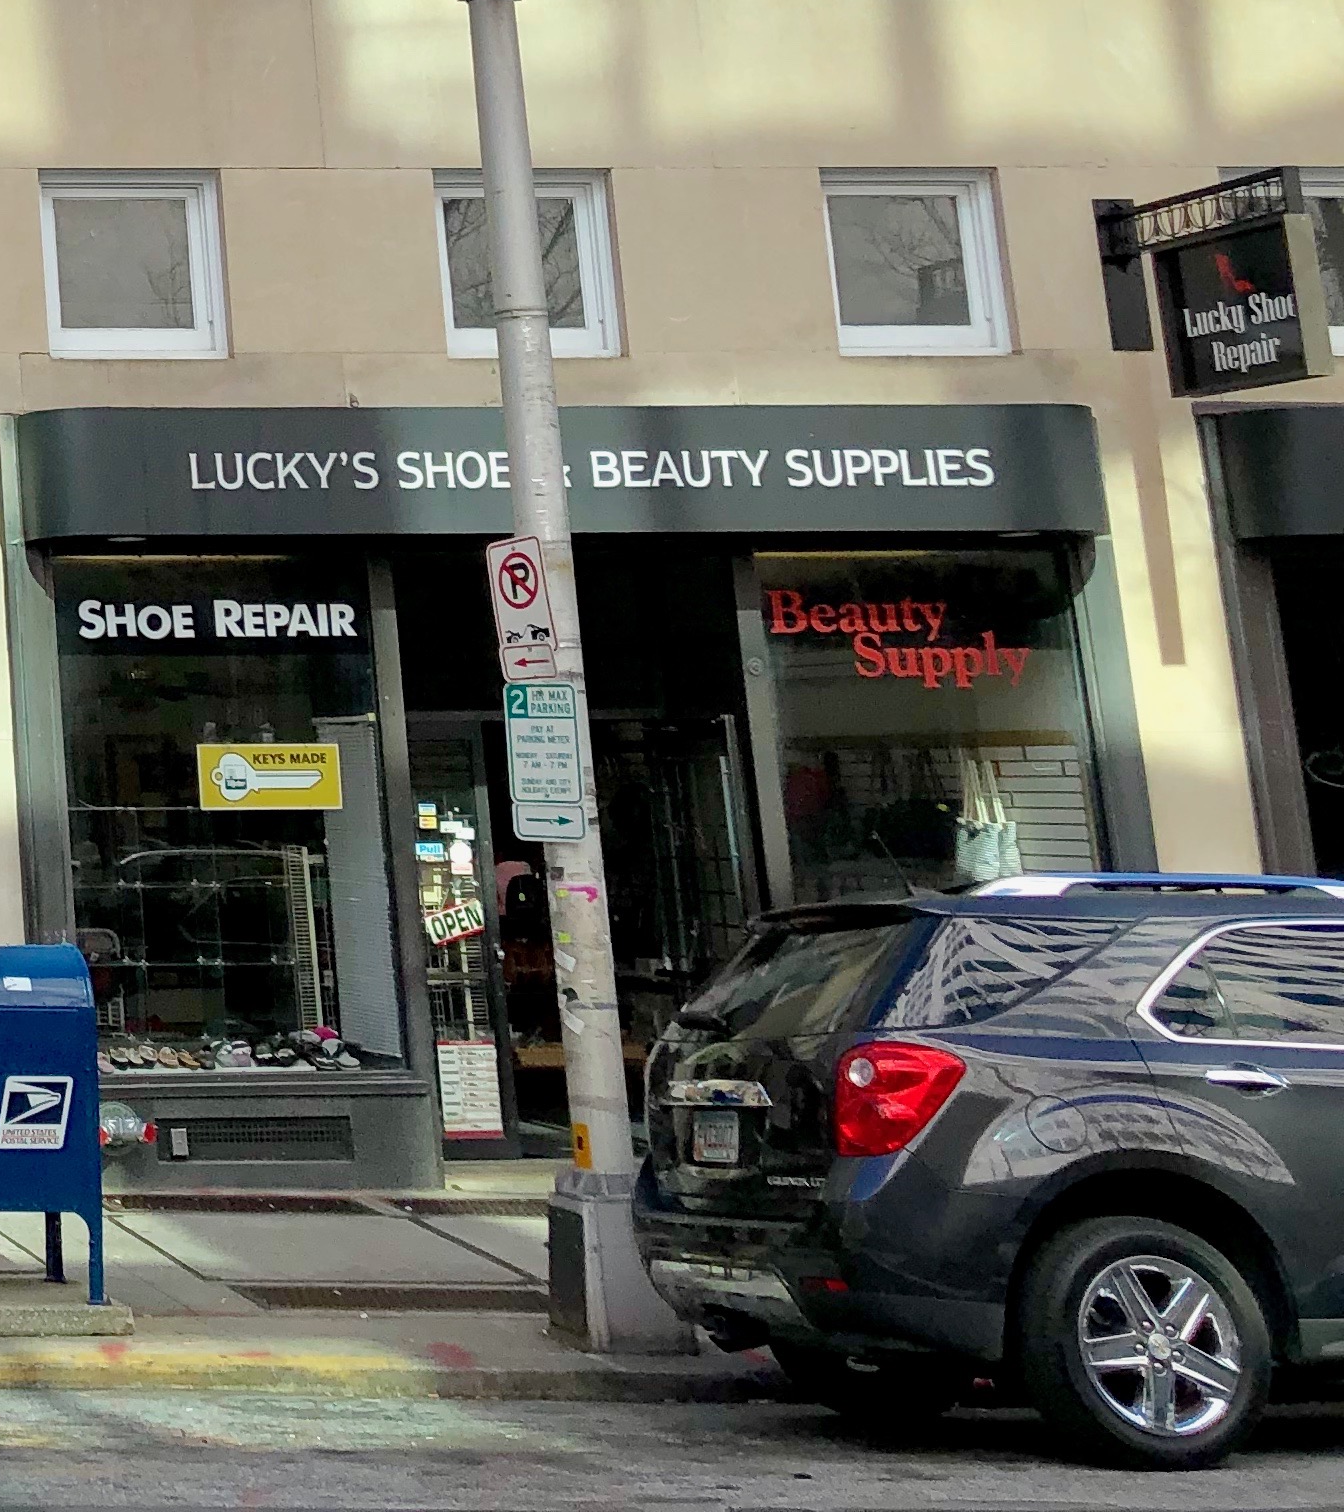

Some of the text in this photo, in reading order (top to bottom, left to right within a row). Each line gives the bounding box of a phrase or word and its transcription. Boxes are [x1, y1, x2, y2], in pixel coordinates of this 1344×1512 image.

[1182, 300, 1245, 338] Lucky
[1211, 332, 1281, 374] Repair
[188, 451, 380, 491] LUCKY'S
[396, 450, 511, 491] SHOE
[592, 449, 768, 489] BEAUTY
[785, 448, 997, 488] SUPPLIES
[78, 598, 358, 640] SHOE REPAIR
[766, 589, 1033, 689] Beauty Supply
[509, 689, 525, 715] 2
[531, 690, 568, 702] HR MAX
[530, 702, 572, 715] PARKING
[530, 725, 554, 734] PAY AT
[252, 752, 327, 765] KEYS MADE
[419, 844, 441, 854] Pull
[430, 903, 484, 941] OPEN
[0, 1136, 60, 1145] POSTAL SERVICE
[2, 1128, 57, 1136] UNITED STATES
